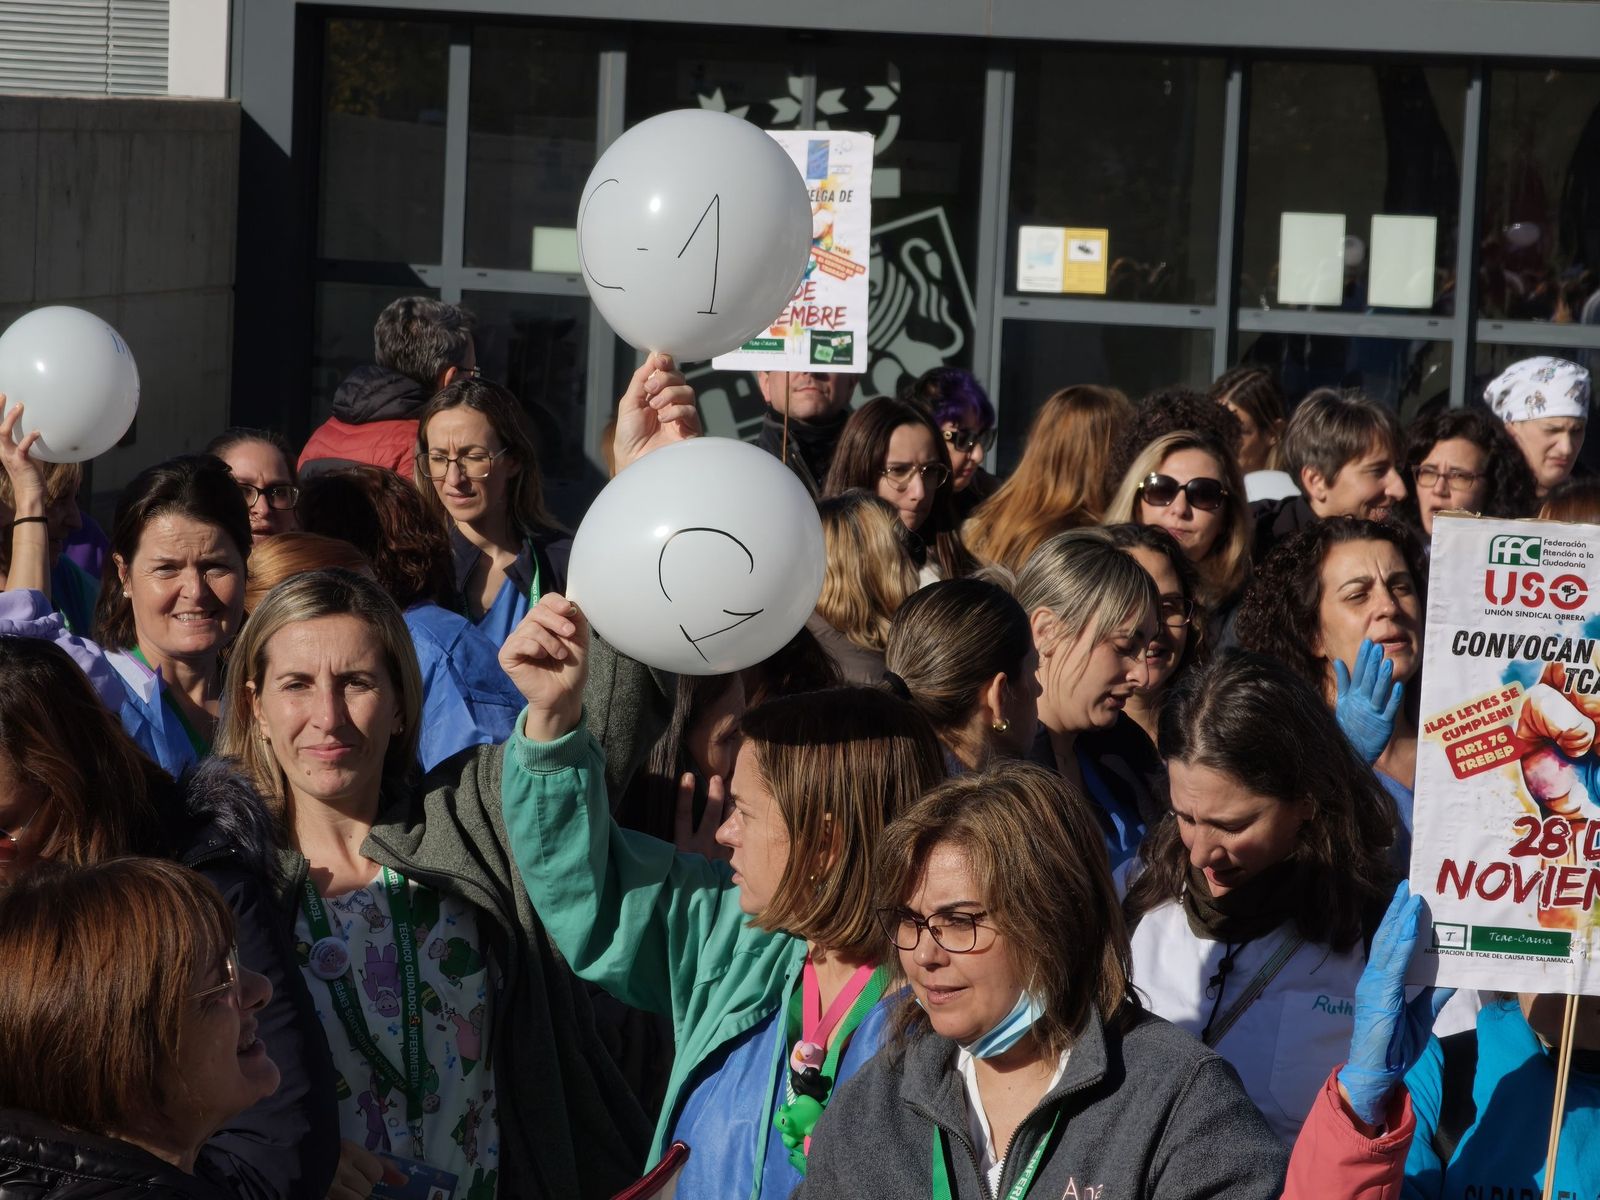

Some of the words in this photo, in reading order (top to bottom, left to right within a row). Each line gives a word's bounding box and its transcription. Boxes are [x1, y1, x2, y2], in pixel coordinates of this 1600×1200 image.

[808, 189, 835, 202] ELGA
[839, 189, 854, 203] DE
[772, 305, 848, 329] EMBRE
[1542, 549, 1577, 558] Atención
[1586, 551, 1595, 559] la
[1543, 538, 1587, 549] Federación
[1542, 559, 1586, 569] Ciudadanía
[1484, 569, 1589, 610] USO
[1484, 608, 1513, 617] UNIÓN
[1515, 610, 1552, 620] SINDICAL
[1554, 613, 1586, 622] OBRERA
[1452, 630, 1595, 664] CONVOCAN
[1456, 695, 1499, 721] LEYES
[1503, 687, 1520, 701] SE
[1441, 705, 1514, 742] CUMPLEN!
[1455, 740, 1488, 759] ART.
[1489, 732, 1508, 748] 76
[1457, 746, 1515, 773] TREBEP
[1508, 815, 1571, 859] 28
[1475, 951, 1491, 959] TCAE
[1491, 952, 1503, 960] DEL
[1504, 953, 1525, 961] CAUSA
[1535, 955, 1574, 964] SALAMANCA
[1312, 994, 1353, 1016] Ruth
[408, 1021, 420, 1088] NFERMERIA
